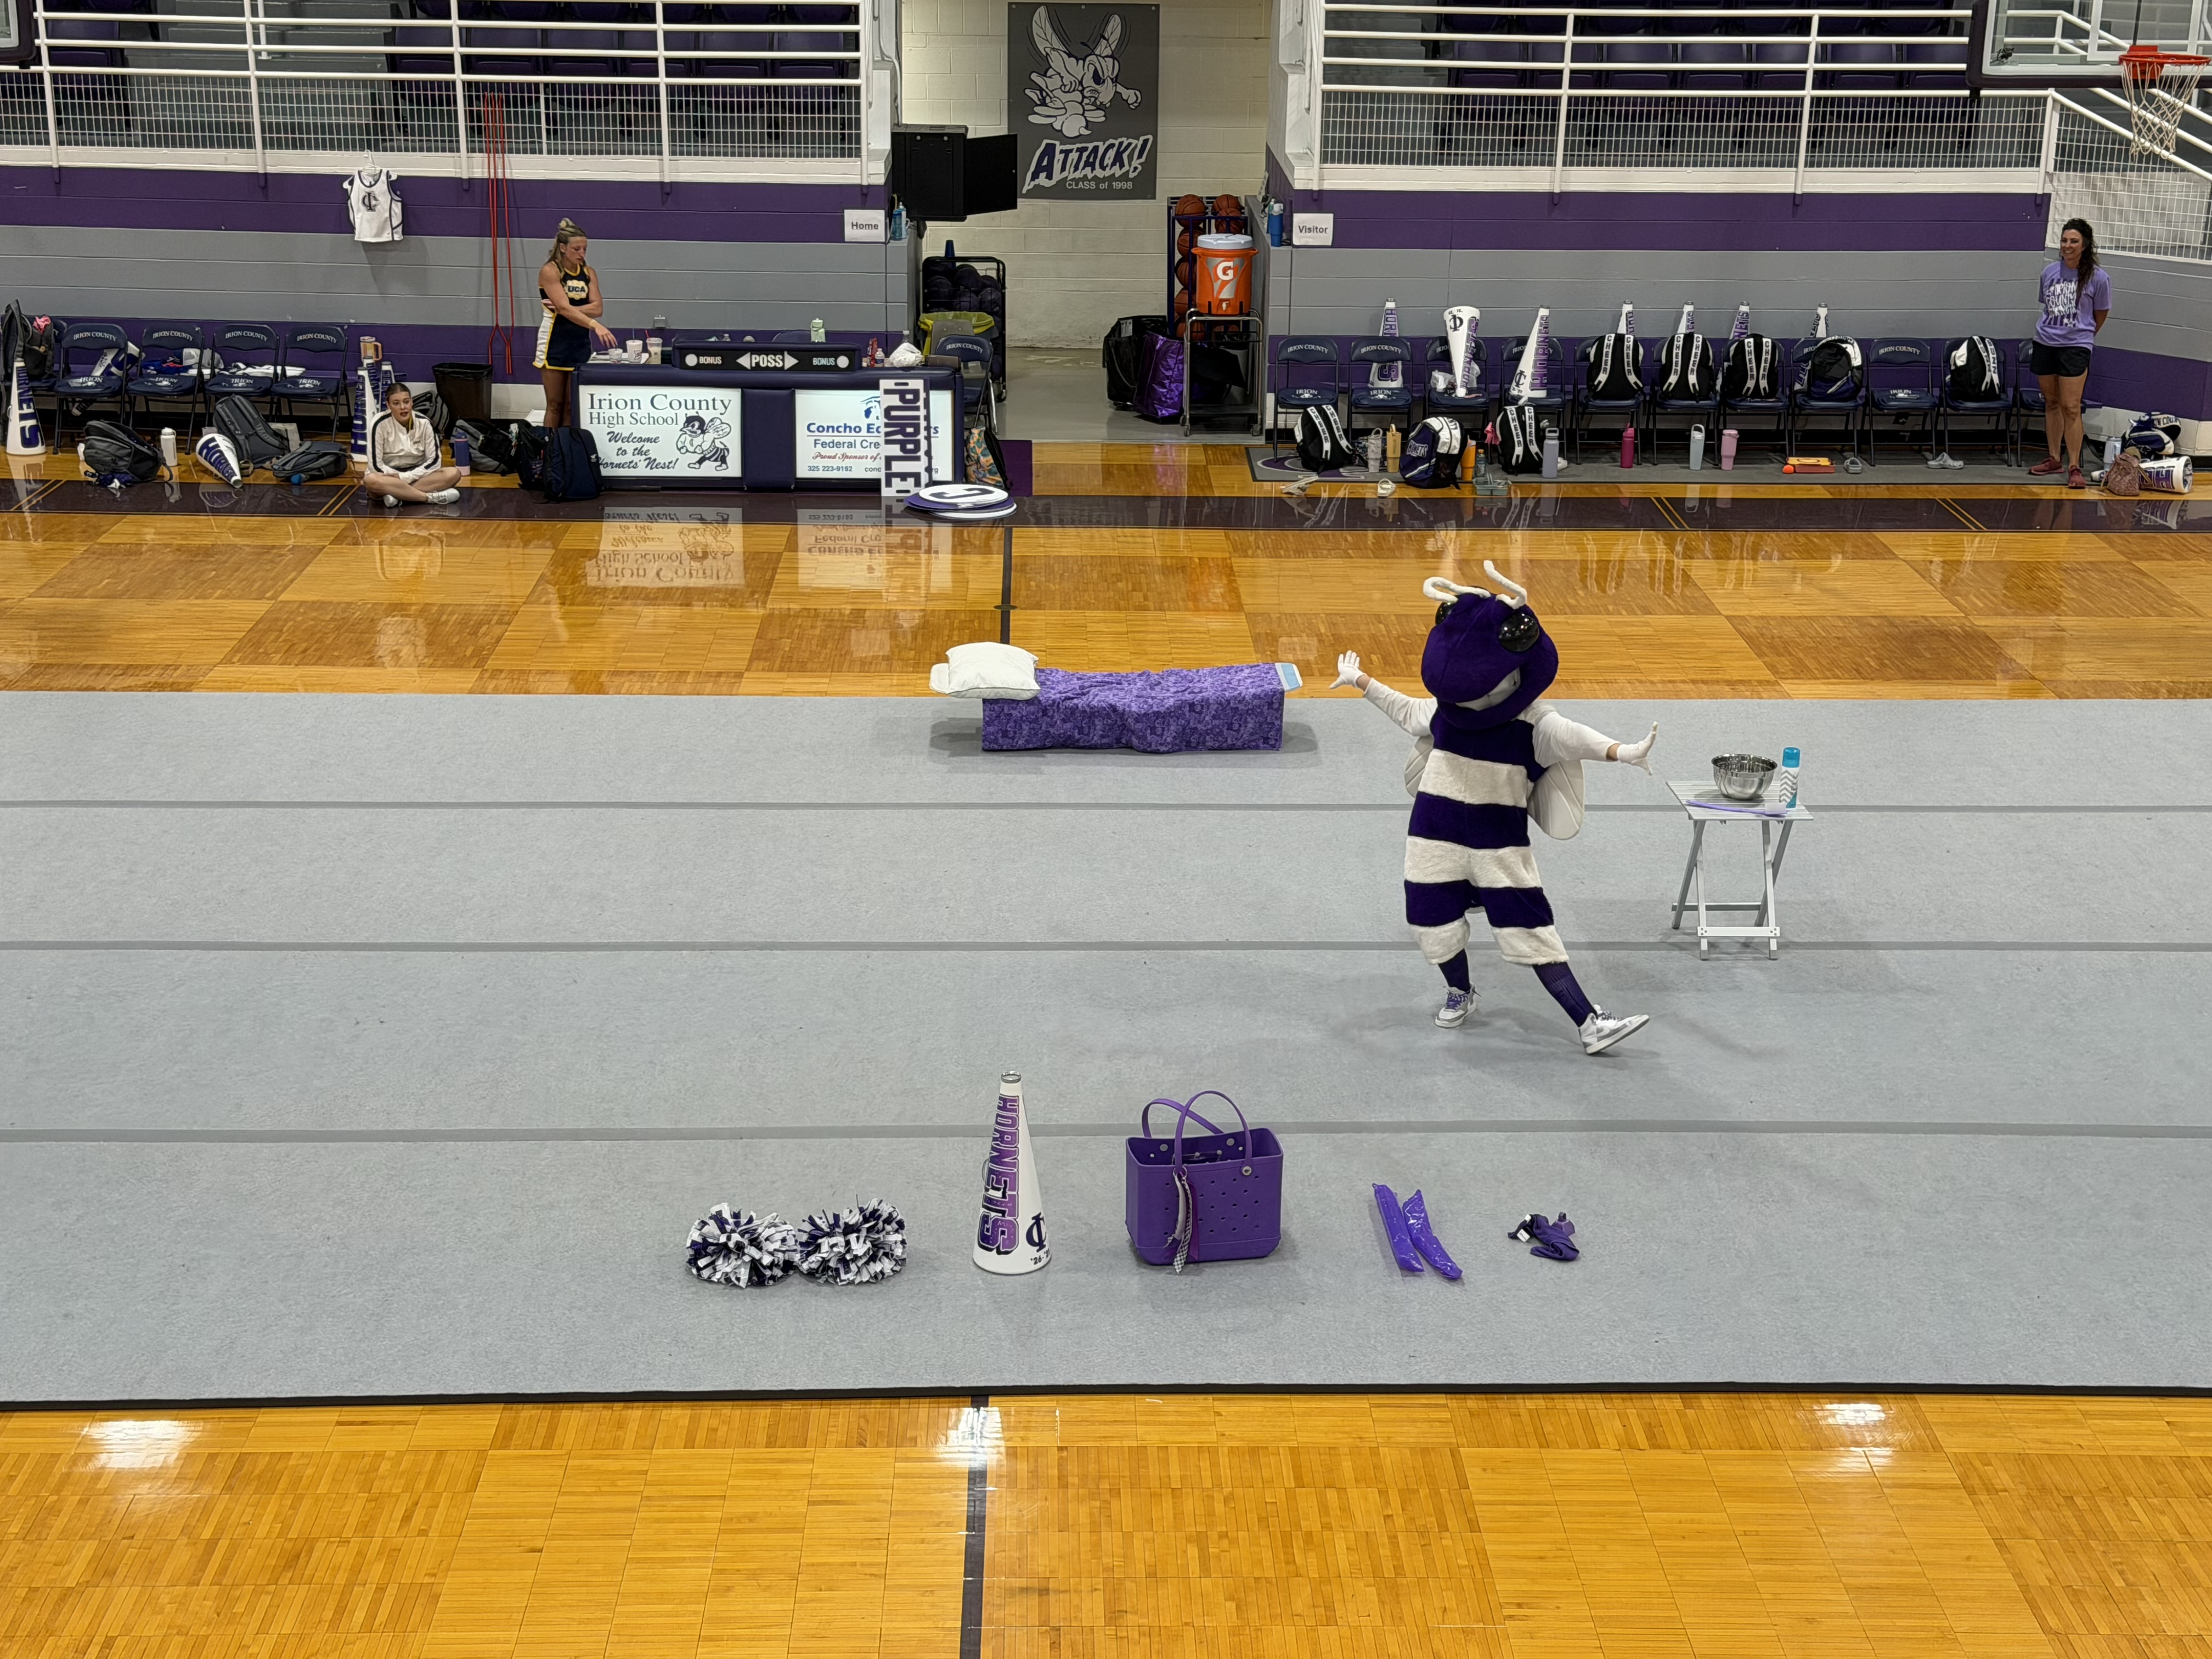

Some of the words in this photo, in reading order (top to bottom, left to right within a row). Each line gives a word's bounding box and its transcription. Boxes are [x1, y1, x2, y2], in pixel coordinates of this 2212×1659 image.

[1025, 136, 1152, 189] ATTACK!
[1066, 181, 1096, 189] CLASS
[1099, 181, 1108, 189] of
[1112, 181, 1133, 189] 1998
[851, 222, 879, 230] Home
[1297, 225, 1329, 234] Visitor
[1217, 261, 1234, 280] G
[74, 331, 91, 340] IRION
[91, 331, 117, 342] COUNTY
[153, 331, 170, 339] IRION
[170, 331, 193, 341] COUNTY
[225, 331, 242, 339] IRION
[243, 331, 268, 342] COUNTY
[297, 333, 314, 341] IRION
[314, 333, 337, 343] COUNTY
[962, 343, 983, 354] COUNTY
[1288, 344, 1304, 353] IRION
[1304, 344, 1328, 354] COUNTY
[1361, 345, 1377, 354] IRION
[1378, 345, 1402, 354] COUNTY
[1878, 346, 1894, 356] IRION
[1895, 345, 1920, 356] COUNTY
[752, 354, 783, 368] POSS
[1602, 335, 1612, 375] CHEER
[1673, 336, 1682, 376] CHEER
[1690, 336, 1701, 376] CHEER
[1746, 341, 1754, 381] CHEER
[1760, 341, 1770, 381] CHEER
[587, 393, 642, 410] Irion
[650, 393, 732, 415] County
[589, 411, 624, 428] High
[629, 412, 679, 426] School
[1308, 408, 1329, 443] CHEER
[1325, 405, 1344, 442] CHEER
[806, 422, 862, 434] Concho
[1509, 409, 1522, 448] CHEER
[606, 431, 660, 444] Welcome
[814, 438, 856, 449] Federal
[883, 388, 922, 488] PURPLE
[616, 447, 628, 456] to
[632, 444, 651, 456] the
[812, 452, 837, 460] Proud
[838, 452, 868, 462] Sponsor
[871, 452, 880, 462] of
[644, 458, 680, 470] Nest!
[977, 1094, 1020, 1255] HORNETS
